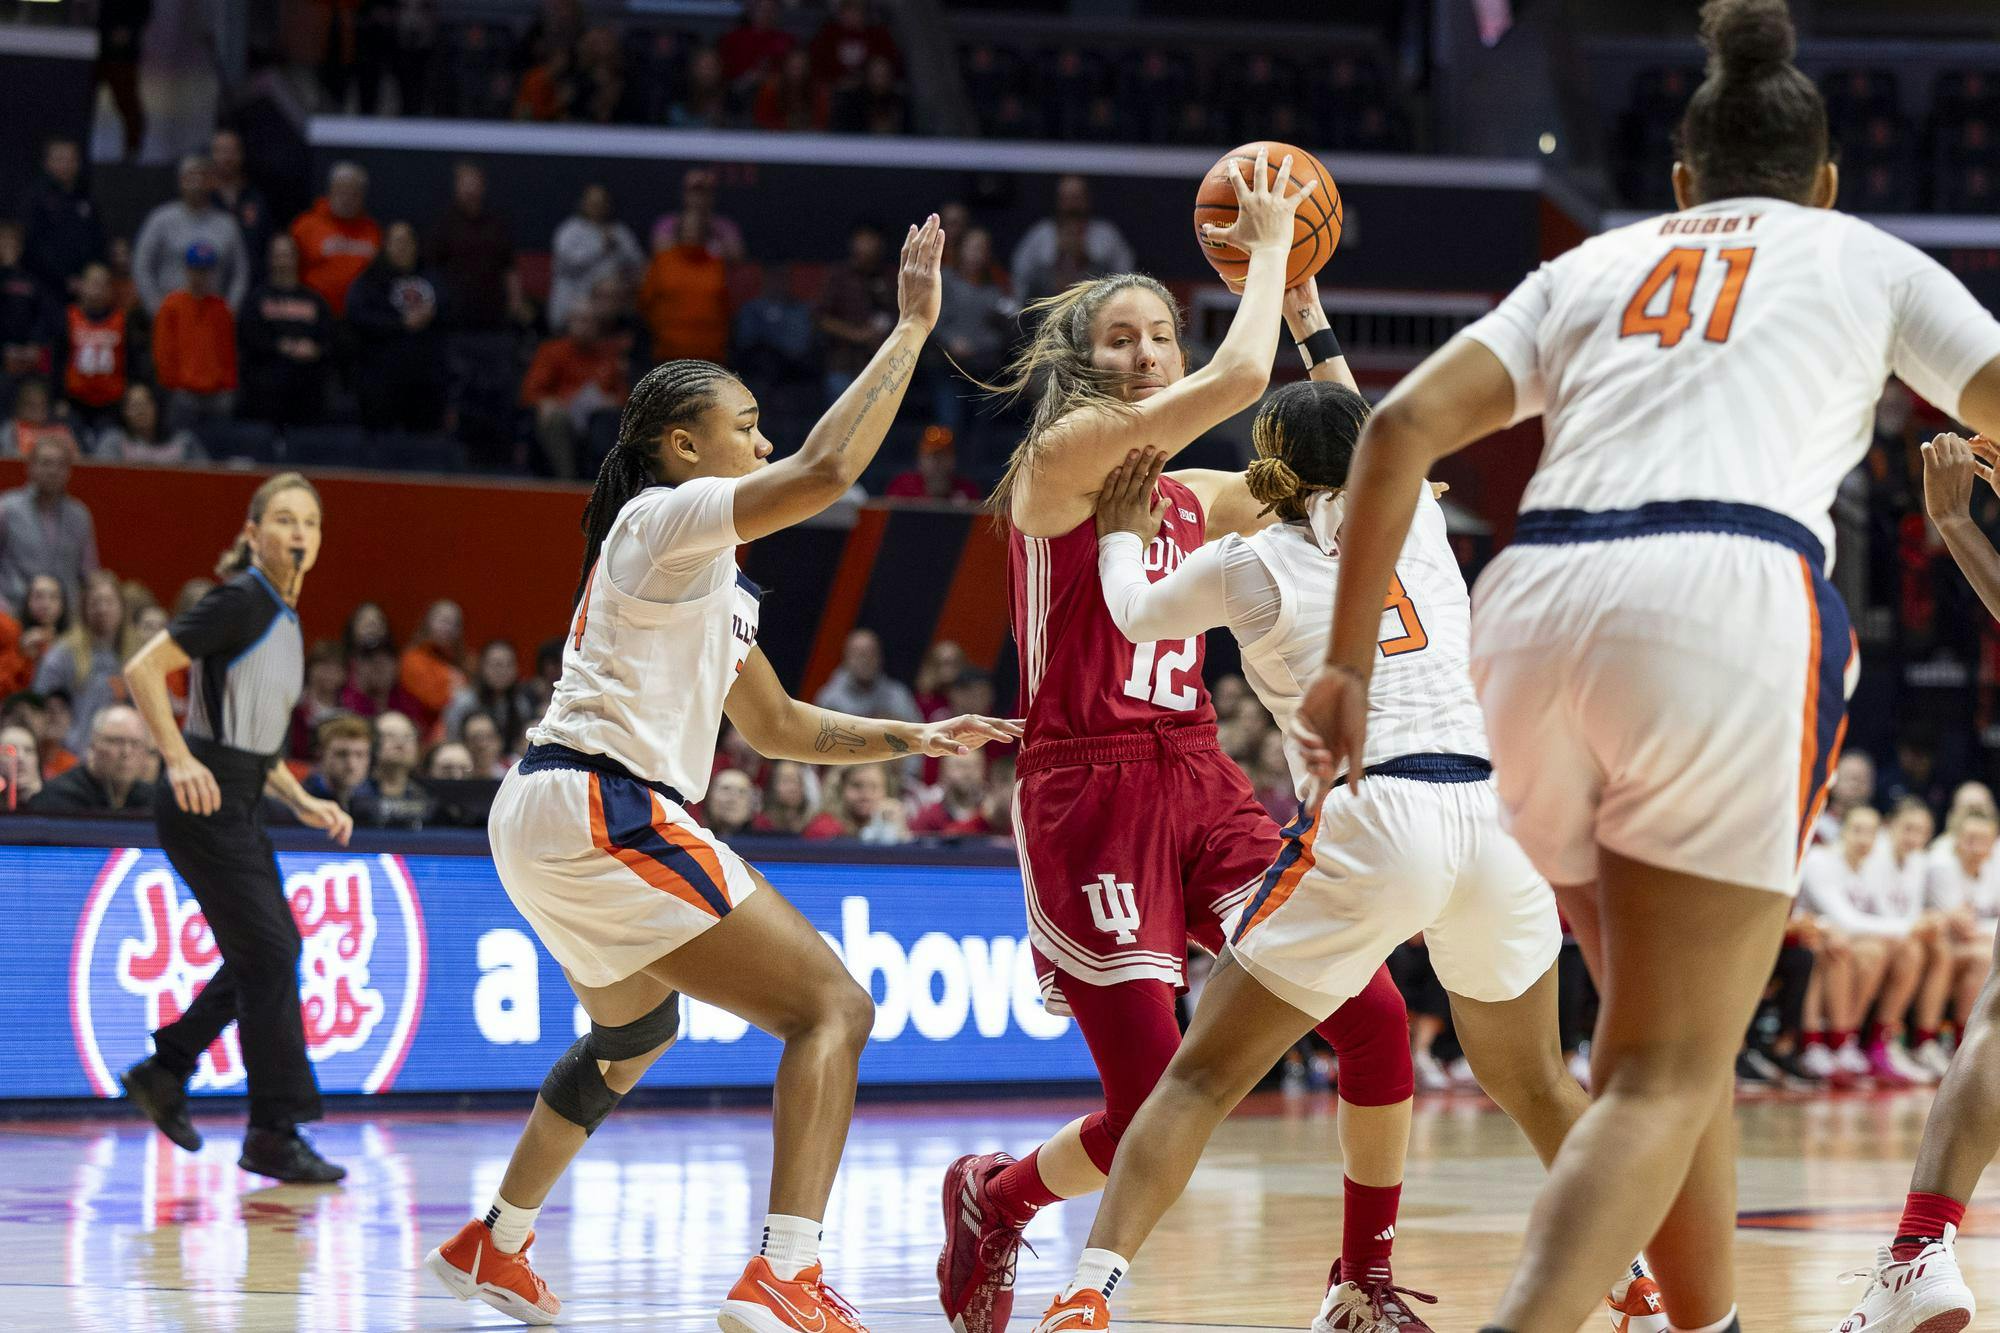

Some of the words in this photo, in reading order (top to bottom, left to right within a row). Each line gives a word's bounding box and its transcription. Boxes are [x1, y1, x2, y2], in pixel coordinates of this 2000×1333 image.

[1618, 246, 1757, 349] 41
[1123, 635, 1198, 711] 12
[472, 928, 541, 1044] a
[818, 896, 1073, 1042] bove
